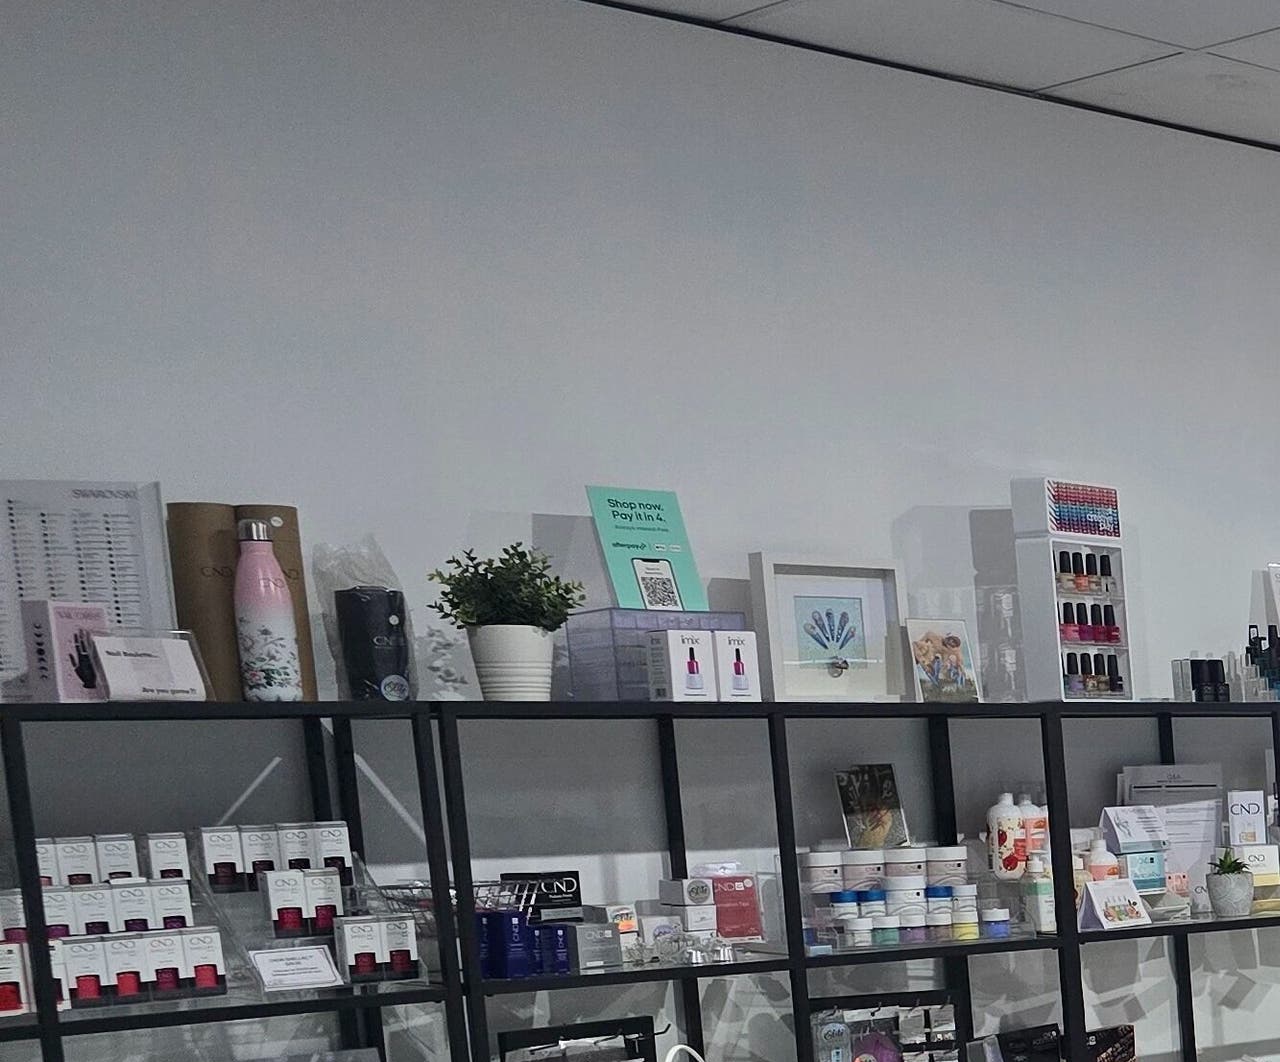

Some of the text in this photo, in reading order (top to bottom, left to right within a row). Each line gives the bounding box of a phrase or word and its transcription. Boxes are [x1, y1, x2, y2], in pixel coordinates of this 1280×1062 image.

[607, 499, 664, 511] Shop now.
[612, 510, 666, 522] Pay it in 4.
[541, 877, 578, 893] CND
